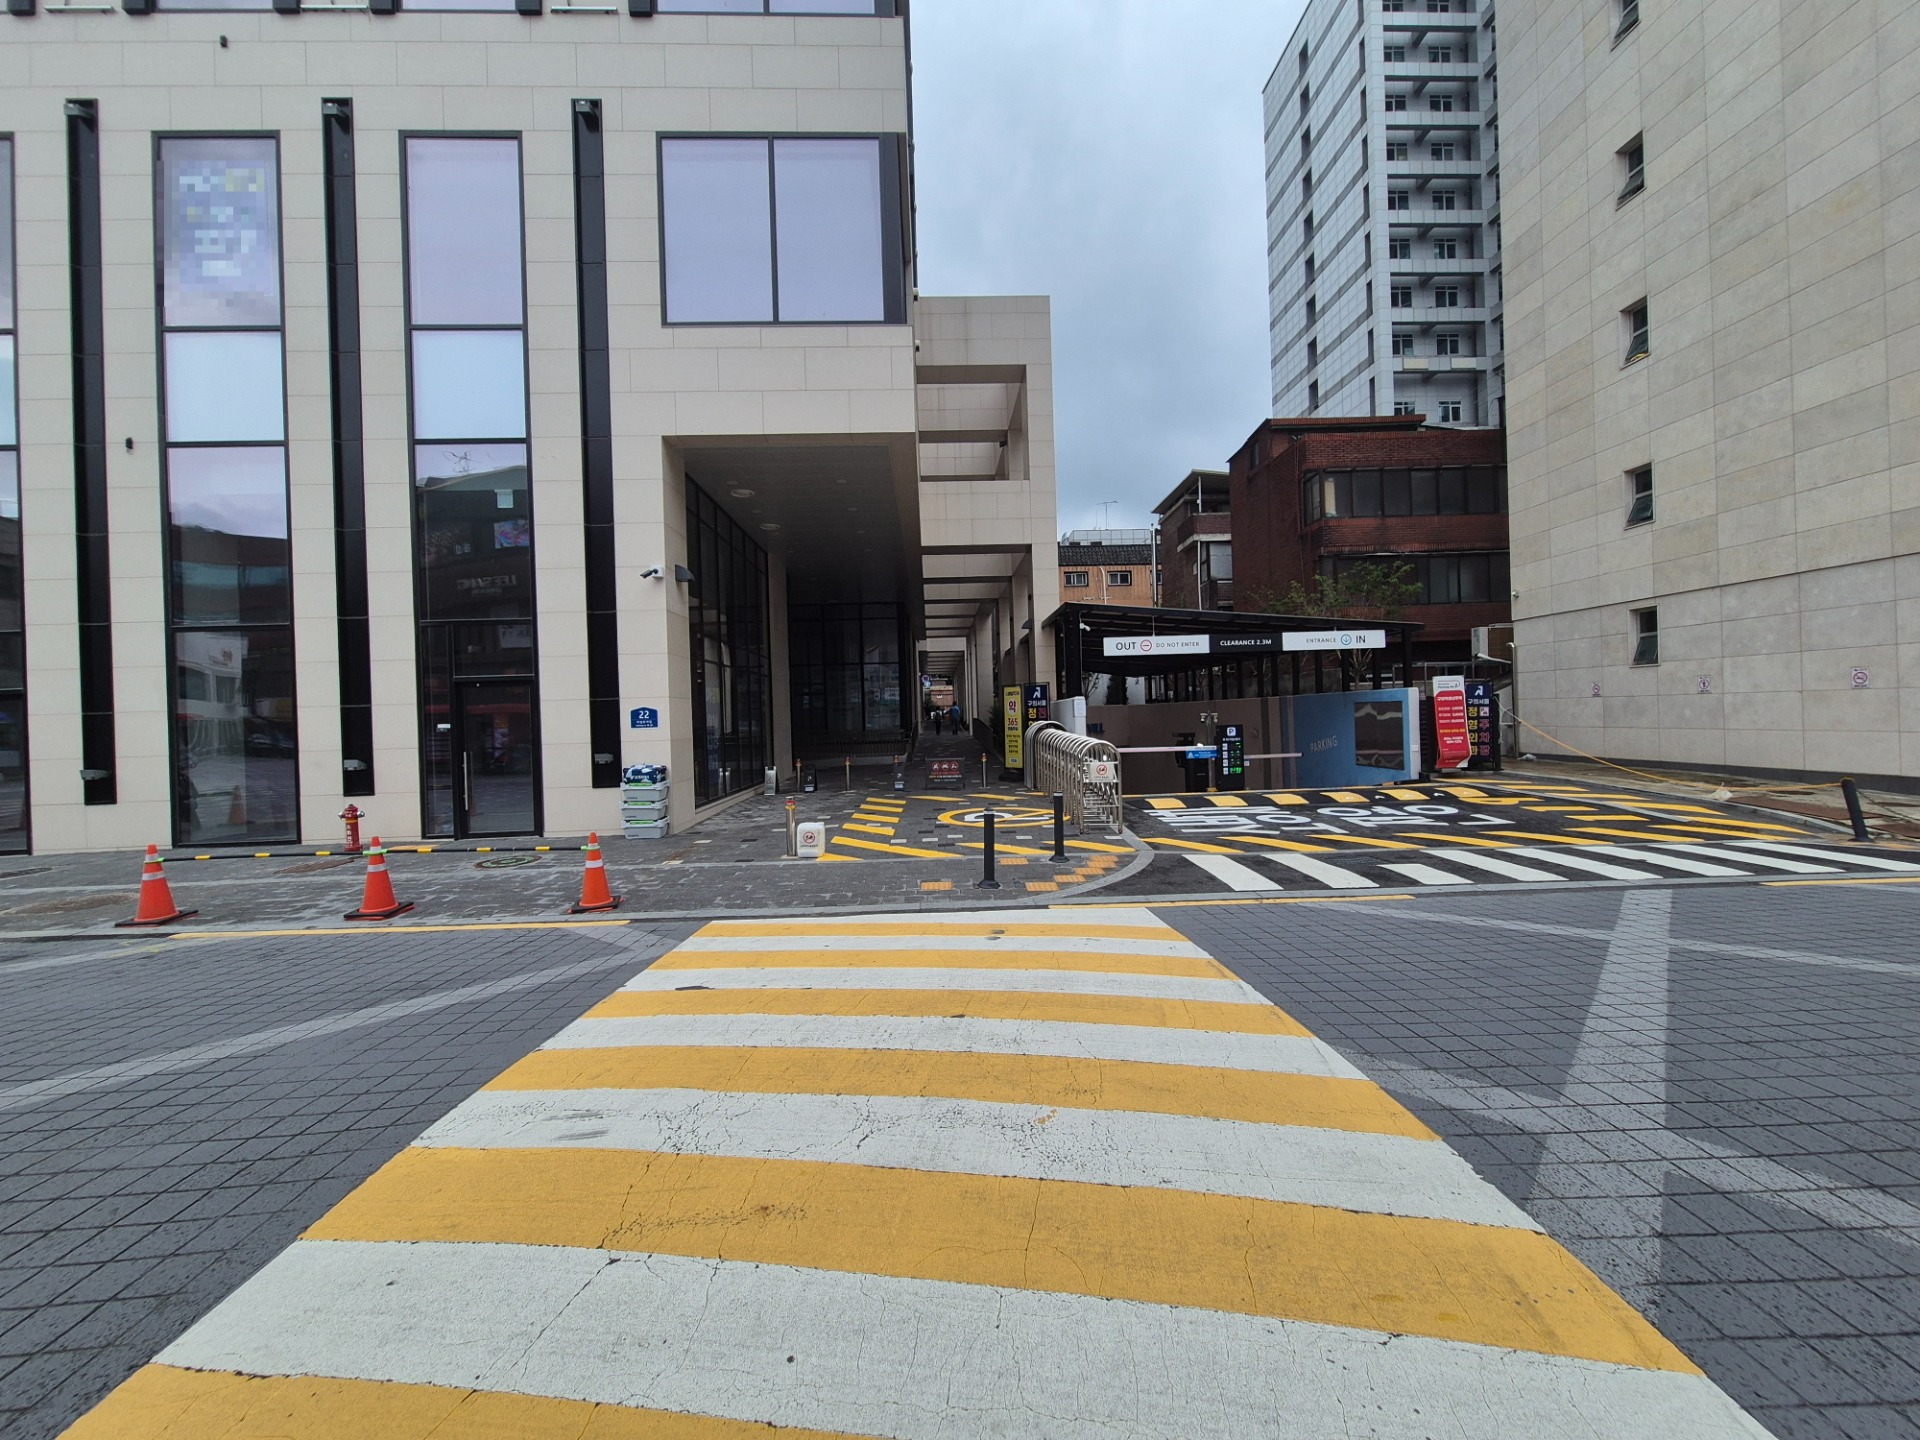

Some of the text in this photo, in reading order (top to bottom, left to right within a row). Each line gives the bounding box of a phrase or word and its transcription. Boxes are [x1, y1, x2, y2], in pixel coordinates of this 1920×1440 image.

[1219, 638, 1272, 647] CLEARANCE 2.3M
[1355, 635, 1366, 644] IN
[1115, 641, 1137, 651] OUT
[1008, 701, 1016, 712] 약
[638, 710, 650, 719] 22
[1007, 718, 1019, 726] 365
[1310, 735, 1338, 752] PARKING
